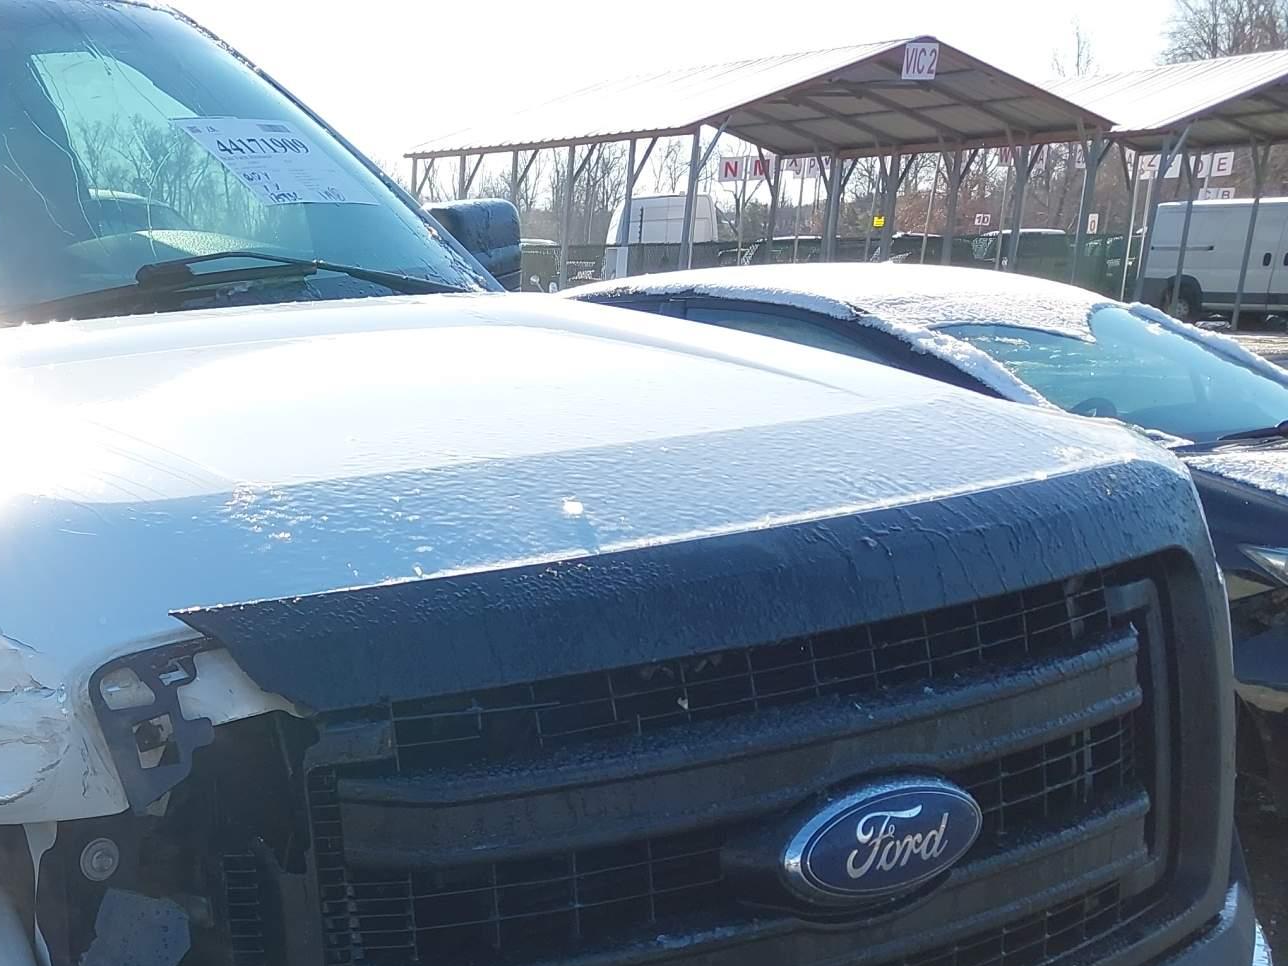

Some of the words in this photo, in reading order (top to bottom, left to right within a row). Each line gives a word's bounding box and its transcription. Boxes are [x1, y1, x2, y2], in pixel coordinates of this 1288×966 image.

[905, 47, 927, 75] VIC
[926, 47, 937, 74] 2
[216, 138, 309, 155] 44171909
[724, 161, 738, 178] N
[1217, 157, 1228, 172] E
[846, 804, 949, 879] Ford
